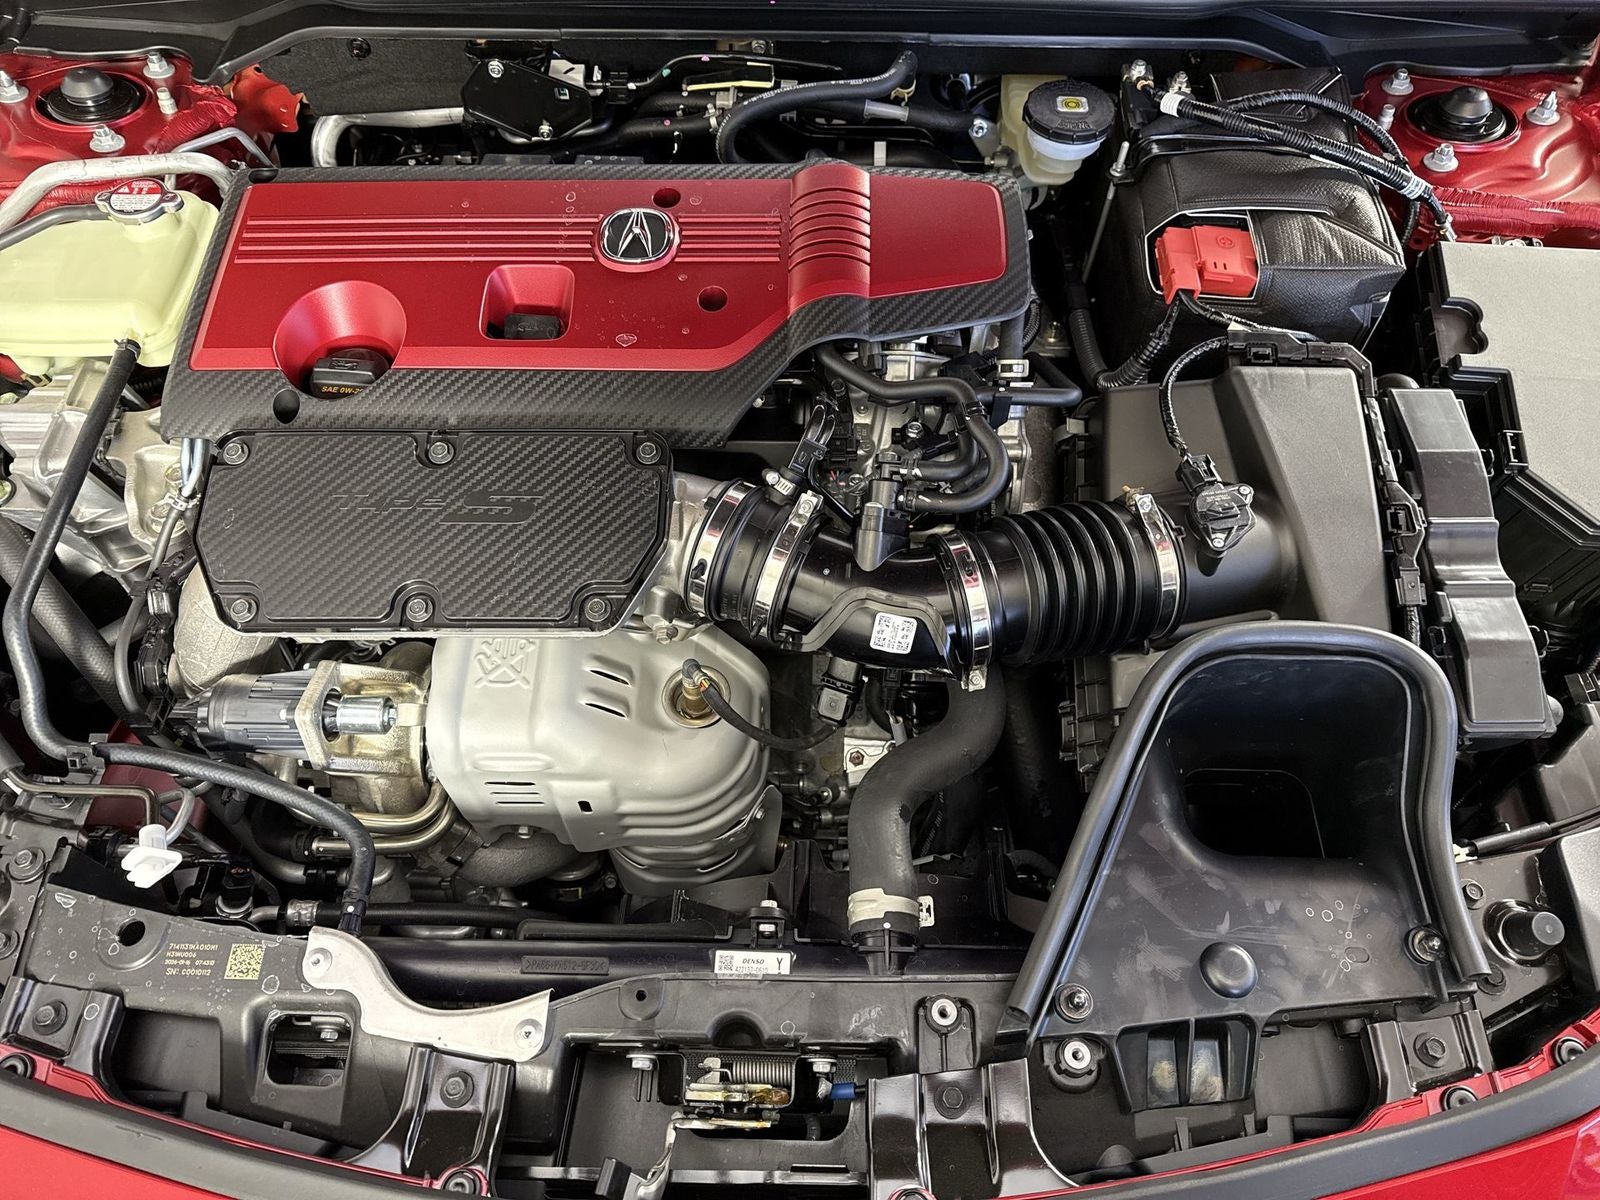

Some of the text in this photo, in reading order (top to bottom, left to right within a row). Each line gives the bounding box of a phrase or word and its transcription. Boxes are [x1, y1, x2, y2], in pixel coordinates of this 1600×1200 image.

[321, 385, 338, 393] SAE
[439, 489, 546, 525] S
[776, 957, 784, 971] Y
